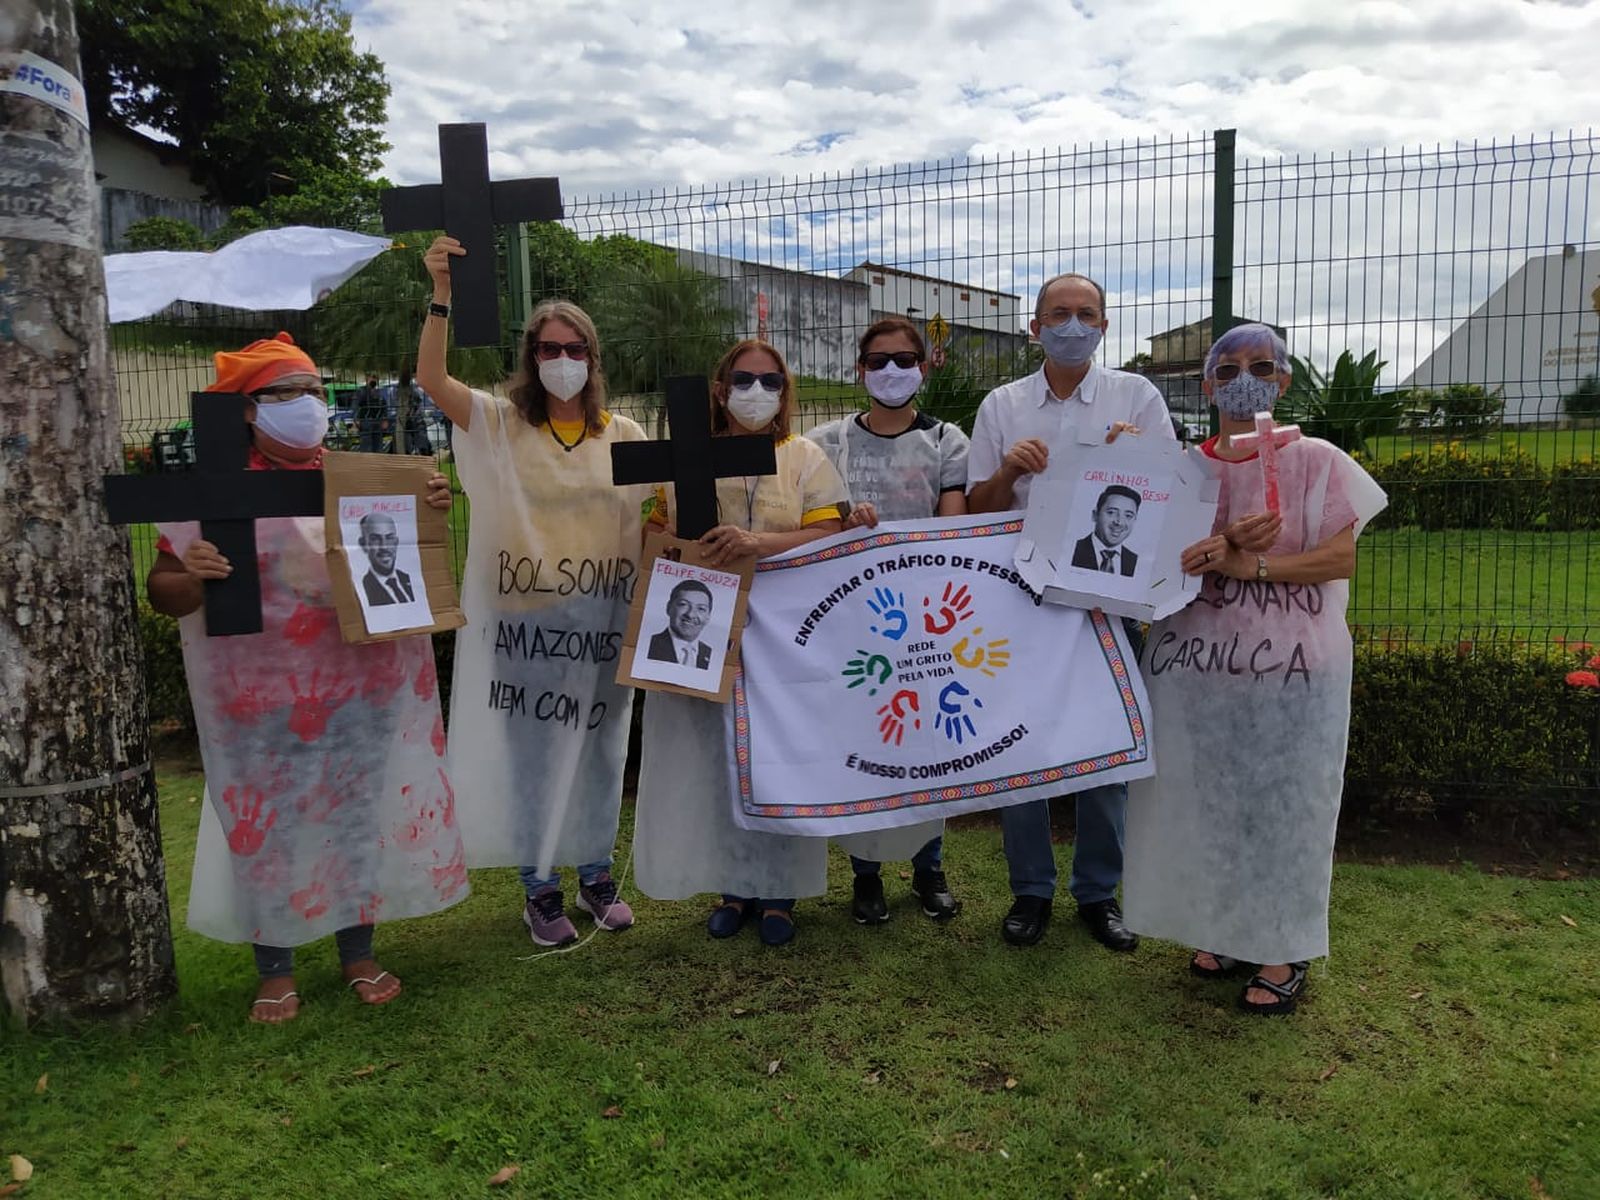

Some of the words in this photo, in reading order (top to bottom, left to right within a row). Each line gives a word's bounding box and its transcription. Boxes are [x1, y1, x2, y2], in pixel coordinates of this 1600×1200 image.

[1084, 470, 1150, 487] CARLINHOS
[794, 575, 862, 647] ENFRENTAR
[863, 567, 875, 581] O
[877, 553, 946, 574] TRÁFICO
[951, 555, 975, 570] DE
[907, 640, 937, 654] REDE
[896, 658, 914, 670] UM
[916, 652, 952, 666] GRITO
[898, 670, 925, 684] PELA
[926, 666, 955, 678] VIDA
[488, 680, 526, 718] NEM
[845, 753, 859, 768] É
[857, 759, 907, 779] NOSSO
[908, 723, 1029, 780] COMPROMISSO!
